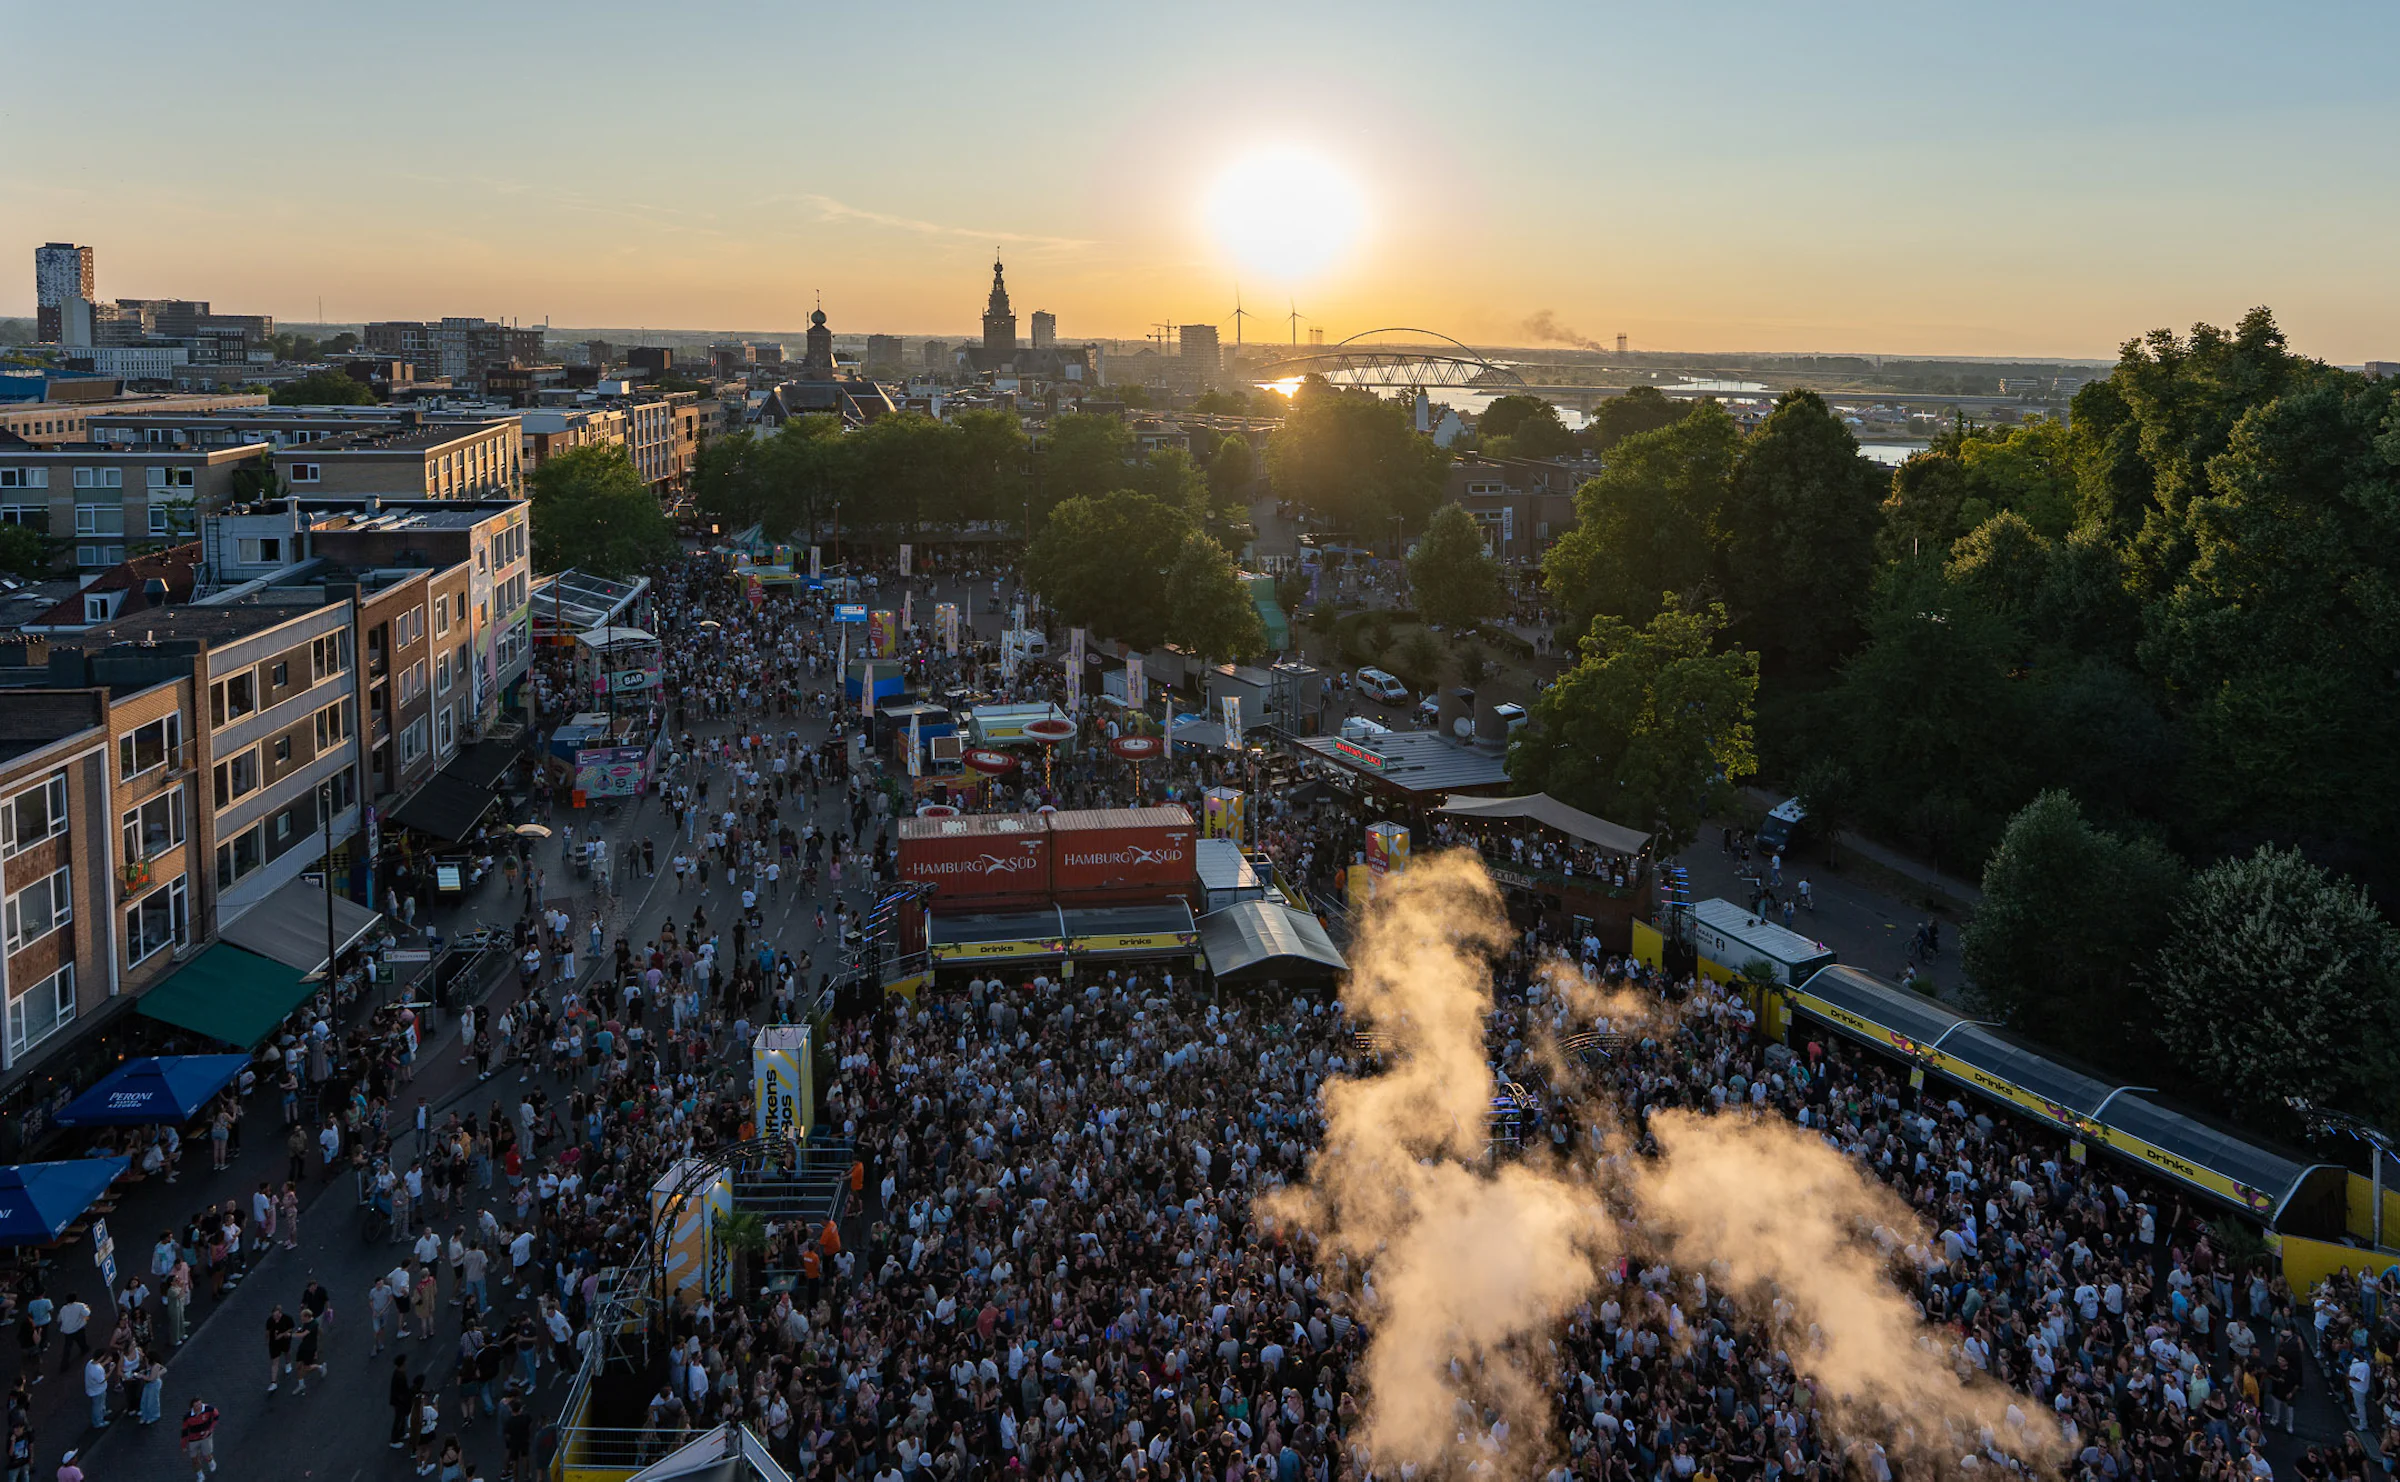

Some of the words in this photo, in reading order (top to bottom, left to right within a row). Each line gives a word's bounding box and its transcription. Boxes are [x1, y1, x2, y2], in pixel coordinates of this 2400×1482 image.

[624, 673, 643, 685] BAR
[913, 860, 983, 876] HAMBURG
[1008, 855, 1037, 870] SÜD
[1064, 852, 1130, 866] HAMBURG
[1155, 847, 1183, 861] SÜD
[1490, 868, 1529, 885] CKTAILS
[980, 945, 1014, 953] Drinks
[1119, 938, 1152, 946] Drinks
[1831, 1009, 1864, 1029] Drinks
[1975, 1073, 2013, 1096] Drinks
[109, 1092, 154, 1101] PERONI
[2147, 1149, 2194, 1176] Drinks
